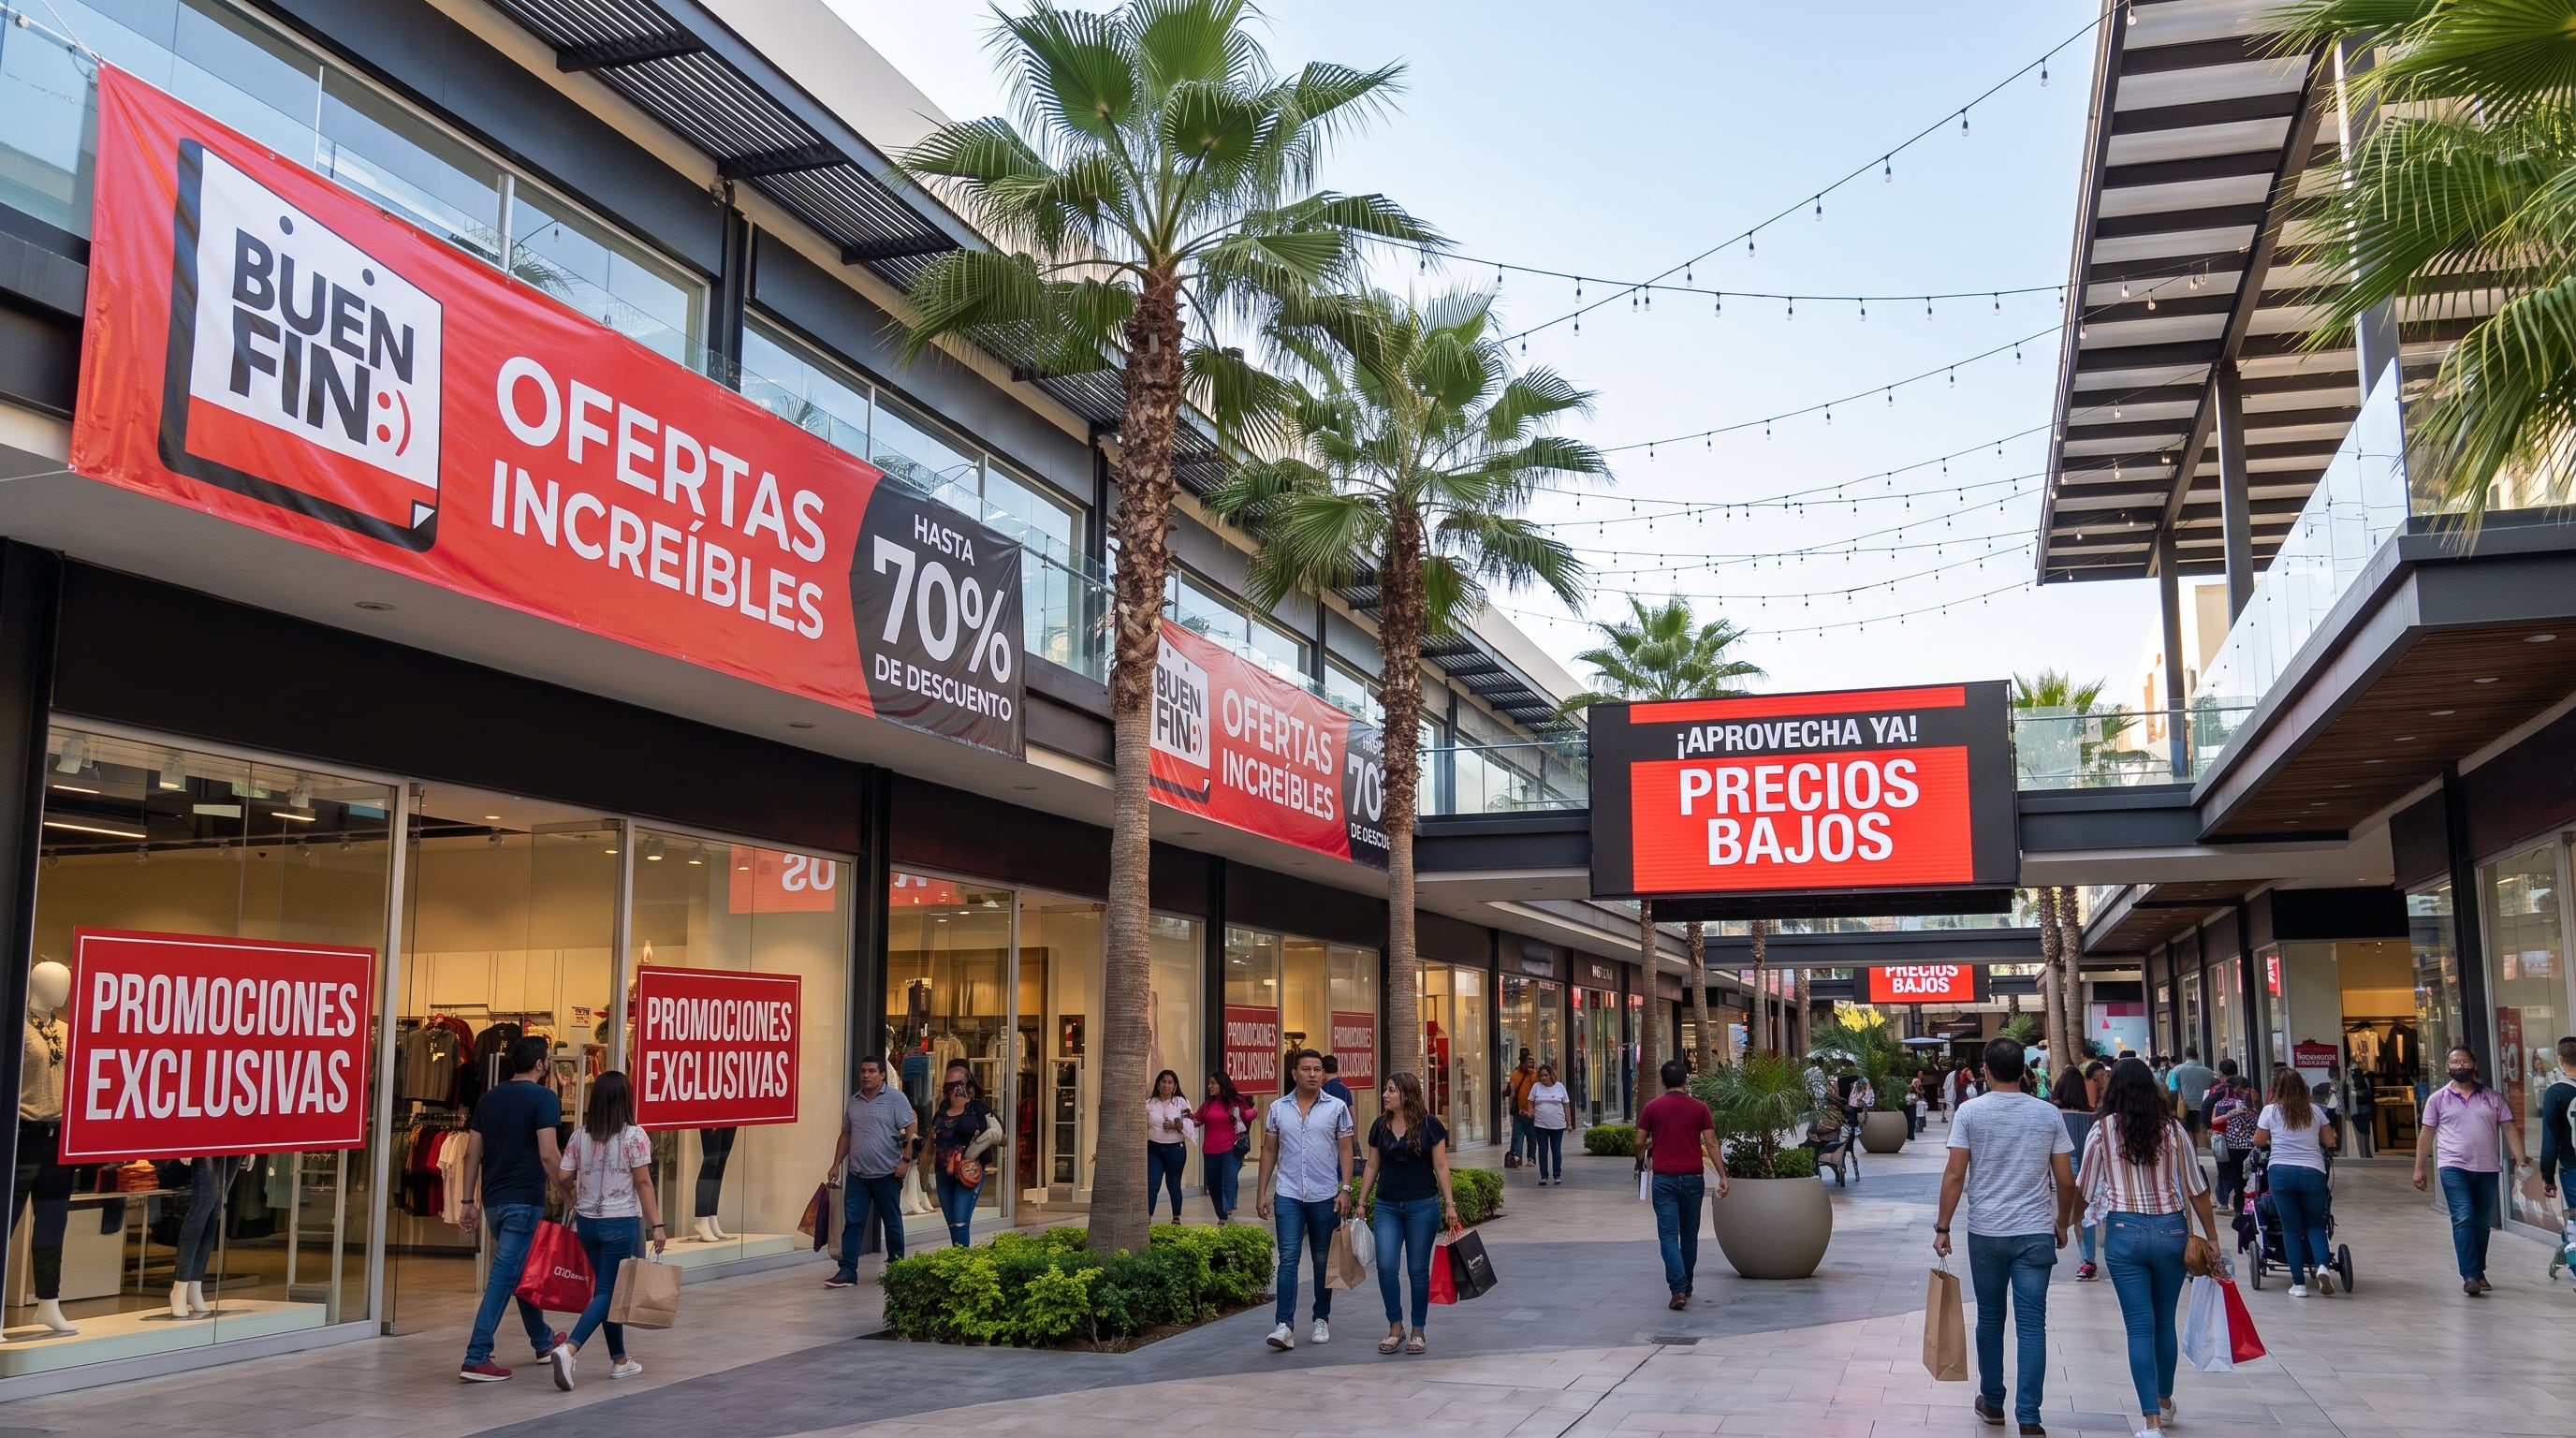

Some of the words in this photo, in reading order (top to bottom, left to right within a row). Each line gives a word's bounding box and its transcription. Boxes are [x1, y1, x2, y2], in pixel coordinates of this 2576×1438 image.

[232, 227, 414, 385] BUEN
[496, 356, 827, 563] OFERTAS
[491, 460, 824, 639] INCREÍBLES
[914, 513, 975, 566] HASTA
[873, 535, 1012, 683] 70%
[875, 653, 900, 688] DE
[907, 668, 1012, 722] DESCUENTO
[1156, 664, 1202, 719] BUEN
[1222, 687, 1333, 775] OFERTAS
[1676, 719, 1862, 760] ¡APROVECHA
[1869, 715, 1918, 744] YA!
[1222, 748, 1334, 821] INCREÍBLES
[1348, 752, 1386, 822] 70
[1679, 758, 1920, 815] PRECIOS
[1351, 823, 1362, 841] DE
[1707, 812, 1894, 866] BAJOS
[92, 972, 358, 1037] PROMOCIONES
[1892, 976, 1951, 993] BAJOS
[647, 996, 793, 1043] PROMOCIONES
[85, 1048, 351, 1121] EXCLUSIVAS
[644, 1049, 789, 1102] EXCLUSIVAS
